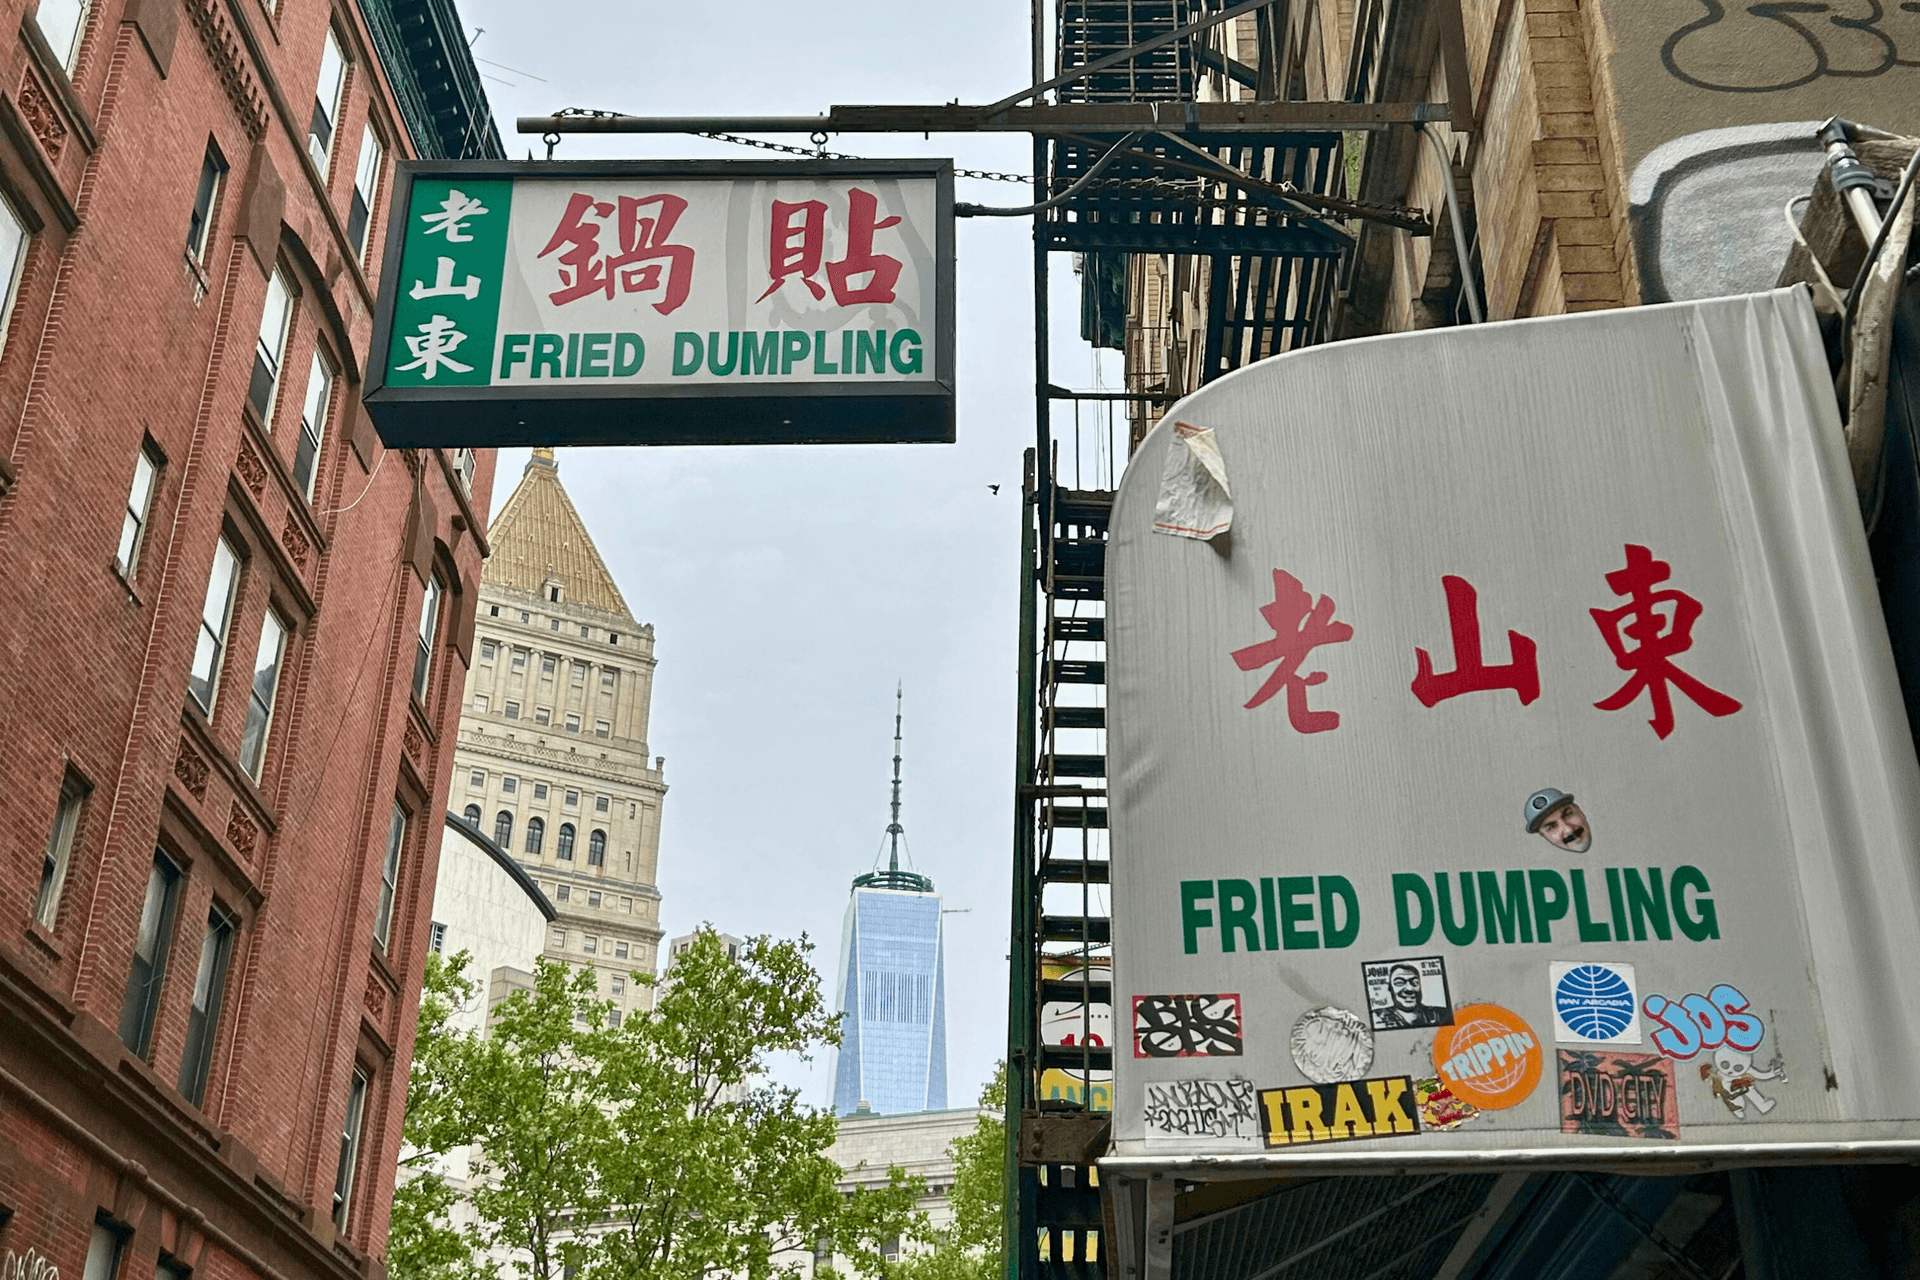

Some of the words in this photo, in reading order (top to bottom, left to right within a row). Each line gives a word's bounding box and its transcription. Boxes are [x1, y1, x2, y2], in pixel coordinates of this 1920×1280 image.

[394, 189, 489, 381] 老山東
[537, 187, 903, 315] 鍋貼
[499, 332, 646, 380] FRIED
[672, 328, 923, 378] DUMPLING
[1230, 544, 1743, 740] 老山東
[1180, 875, 1361, 954] FRIED
[1391, 865, 1721, 947] DUMPLING
[1441, 1031, 1534, 1081] TRIPPIN
[1570, 1072, 1615, 1116] DVD
[1622, 1074, 1664, 1118] CITY
[1262, 1079, 1415, 1146] IRAK
